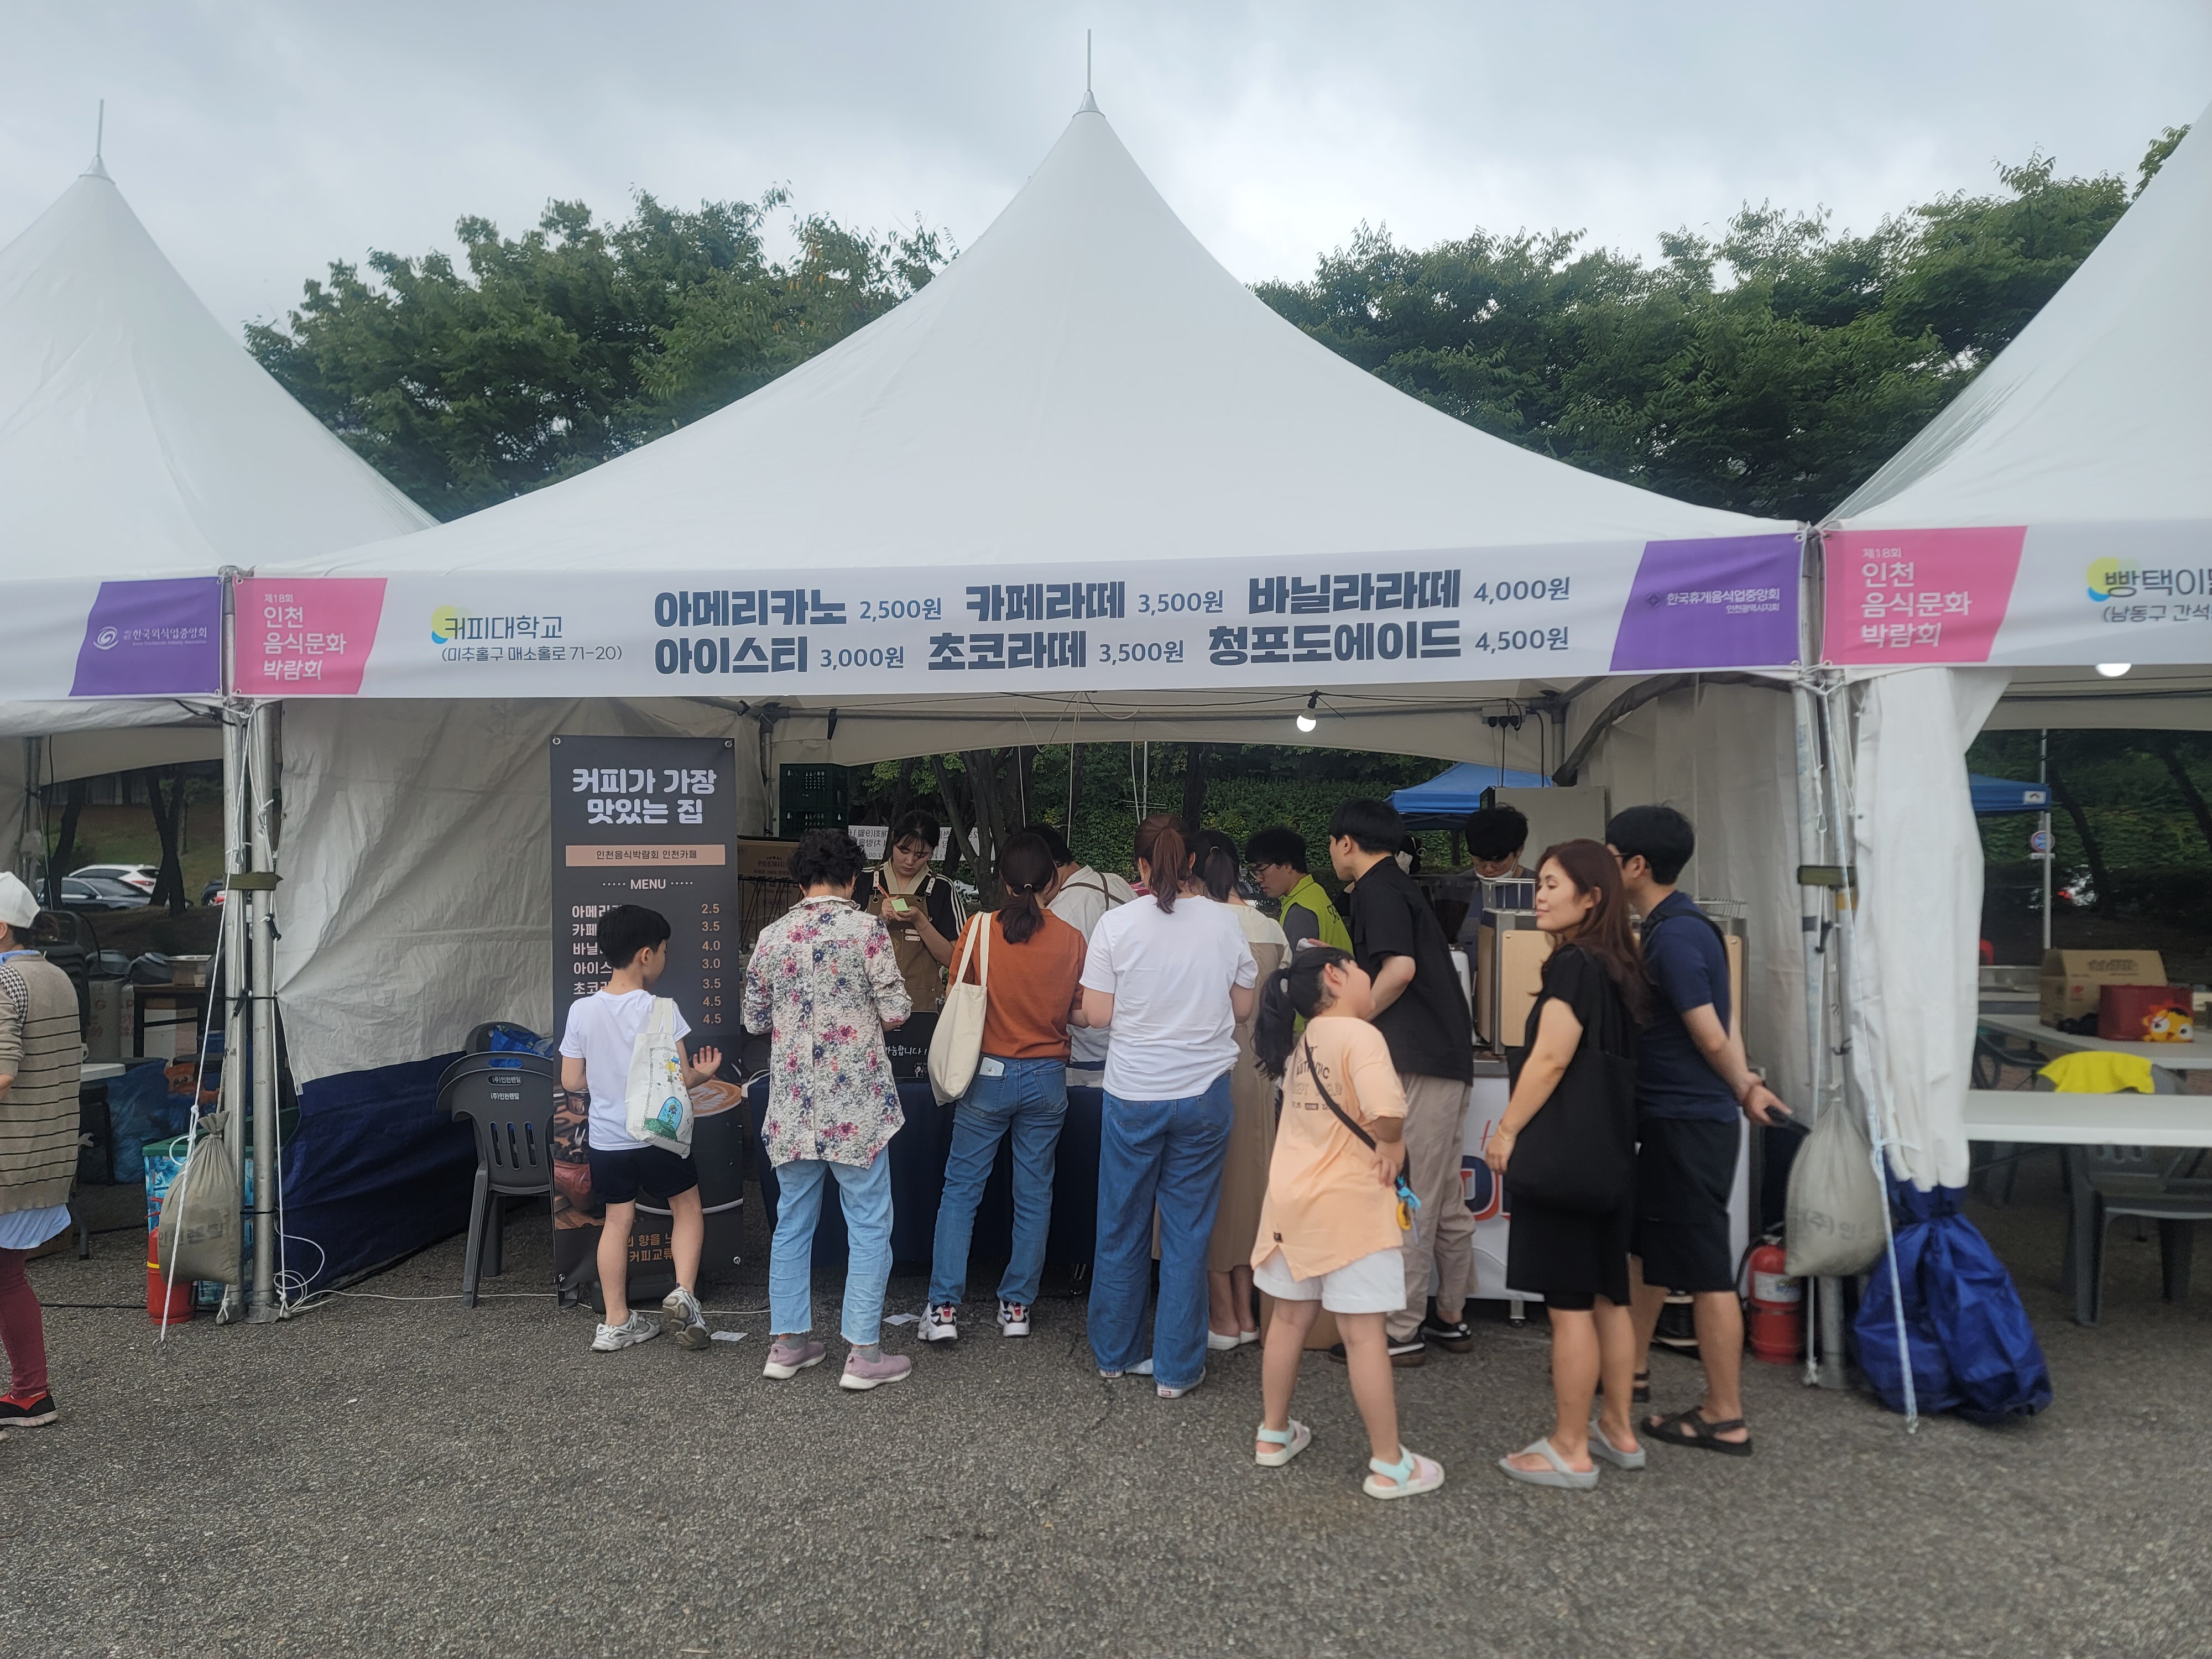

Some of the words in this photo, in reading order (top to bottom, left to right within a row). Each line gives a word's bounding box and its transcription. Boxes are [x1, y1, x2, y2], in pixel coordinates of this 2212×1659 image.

[1863, 547, 1902, 559] 제18회
[1862, 562, 1914, 587] 인천
[264, 594, 294, 603] 제18회
[655, 589, 847, 627] 아메리카노
[859, 597, 941, 622] 2,500원
[966, 581, 1125, 622] 카페라떼
[1138, 589, 1223, 617] 3,500원
[1249, 569, 1461, 614] 바닐라라떼
[1473, 577, 1570, 605] 4,000원
[1667, 588, 1780, 606] 한국휴게음식업중앙회
[1860, 591, 1973, 618] 음식문화
[263, 606, 304, 628] 인천
[2104, 604, 2167, 623] (남동구
[2174, 604, 2212, 622] 간석
[445, 615, 562, 640] 커피대학교
[1861, 622, 1942, 648] 박람회
[263, 632, 347, 655] 음식문화
[655, 636, 807, 674] 아이스티
[820, 646, 904, 671] 3,000원
[928, 630, 1087, 670] 초코라떼
[1099, 640, 1183, 666] 3,500원
[1208, 620, 1461, 666] 청포도에이드
[1475, 627, 1569, 654] 4,500원
[442, 646, 504, 662] (미추홀구
[508, 646, 566, 661] 매소홀로
[570, 645, 623, 661] 71-20)
[263, 659, 322, 681] 박람회
[572, 768, 656, 794] 커피가
[664, 769, 717, 794] 가장
[587, 799, 669, 824] 맛있는
[677, 799, 702, 824] 집
[596, 851, 659, 860] 인천음식박람회
[662, 850, 697, 859] 인천카페
[630, 879, 666, 889] MENU
[701, 904, 719, 914] 2.5
[702, 921, 720, 931] 3.5
[573, 942, 604, 956] 바닐
[702, 941, 721, 951] 4.0
[702, 958, 721, 969] 3.0
[702, 978, 721, 989] 3.5
[703, 997, 721, 1006] 4.5
[703, 1014, 722, 1024] 4.5
[491, 1092, 520, 1100] (주)인천렌탈
[638, 1234, 661, 1246] 향을
